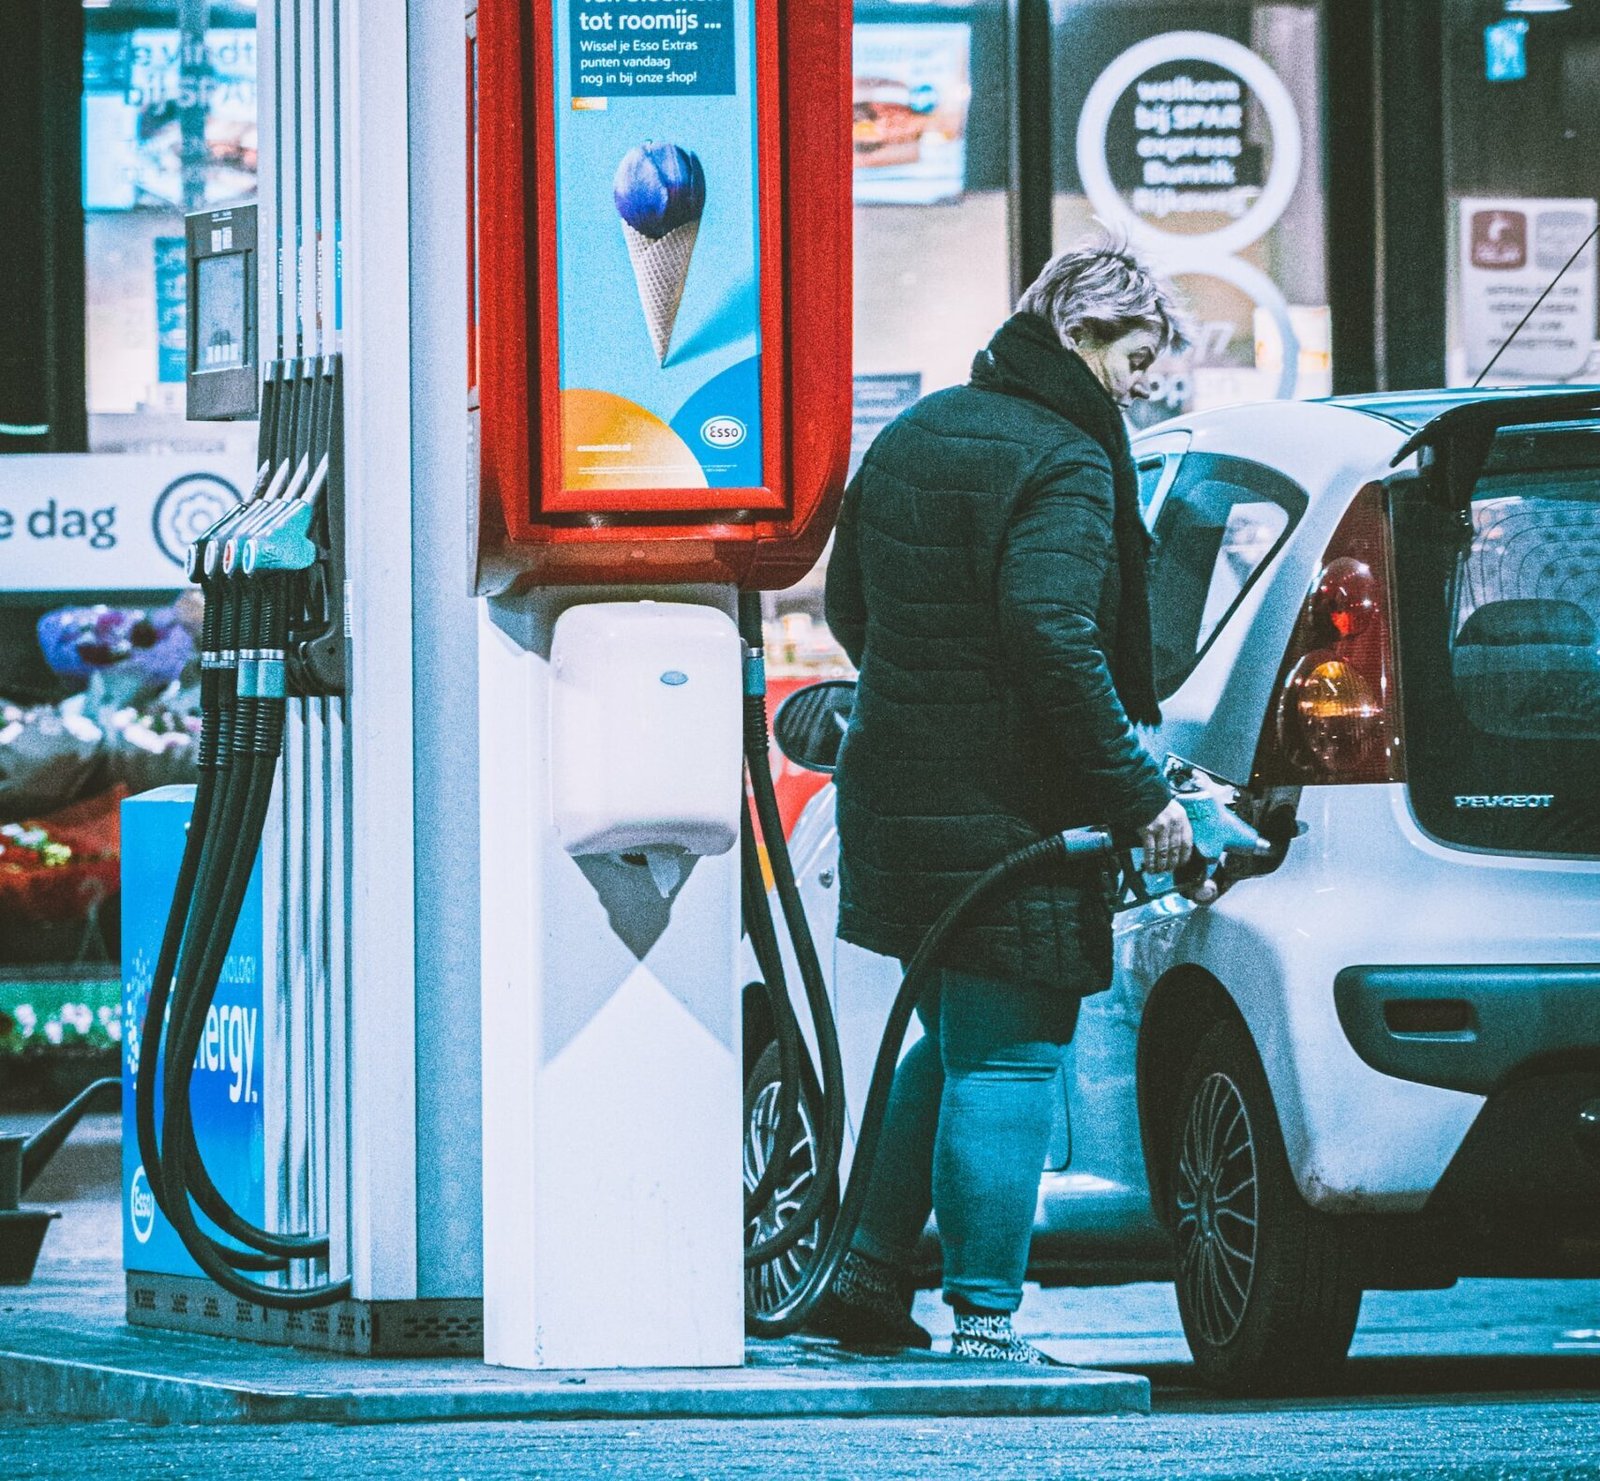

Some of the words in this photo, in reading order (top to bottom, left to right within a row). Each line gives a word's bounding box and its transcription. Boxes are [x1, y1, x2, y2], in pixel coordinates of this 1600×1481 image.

[579, 12, 613, 30] tot
[619, 9, 698, 35] roomijs
[580, 40, 617, 51] Wissel
[619, 41, 630, 54] je
[633, 40, 659, 50] Esso
[662, 39, 698, 50] Extras
[580, 57, 620, 69] punten
[623, 56, 671, 69] vandaag
[580, 74, 603, 85] nog
[606, 72, 616, 83] in
[619, 72, 633, 86] bij
[635, 73, 663, 83] onze
[666, 72, 697, 85] shop!
[28, 496, 117, 550] dag
[1454, 794, 1555, 807] PEUGEOT
[220, 955, 256, 984] NOLOGY
